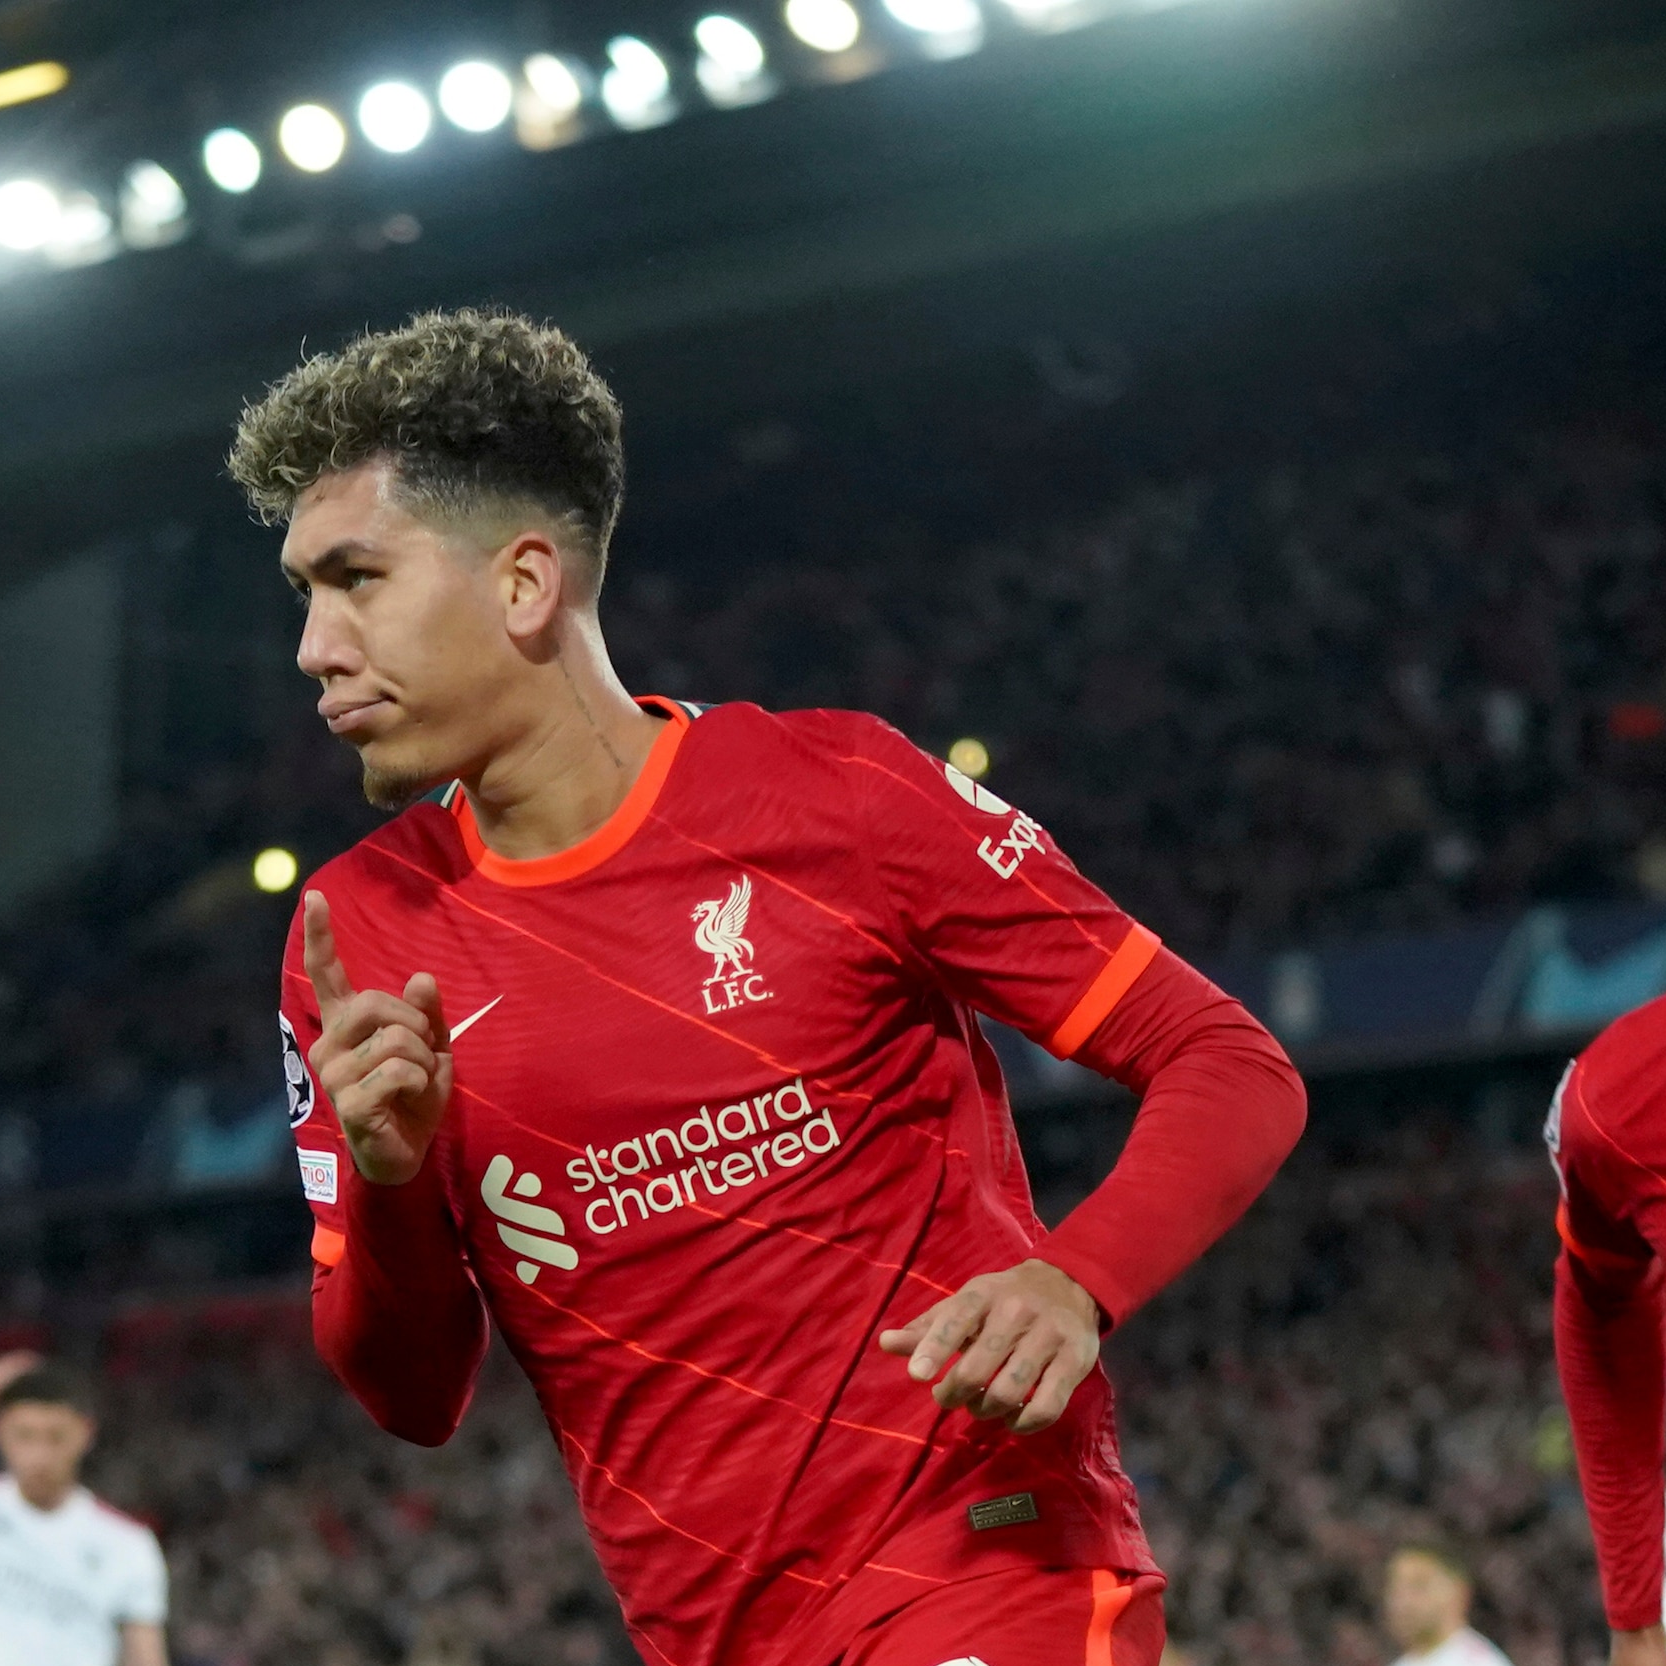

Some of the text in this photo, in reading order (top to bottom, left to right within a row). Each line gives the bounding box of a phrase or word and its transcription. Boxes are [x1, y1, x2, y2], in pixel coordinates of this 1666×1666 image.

[977, 810, 1046, 879] Exp
[701, 975, 774, 1015] L.F.C.
[565, 1077, 813, 1193] standard
[585, 1107, 841, 1235] chartered
